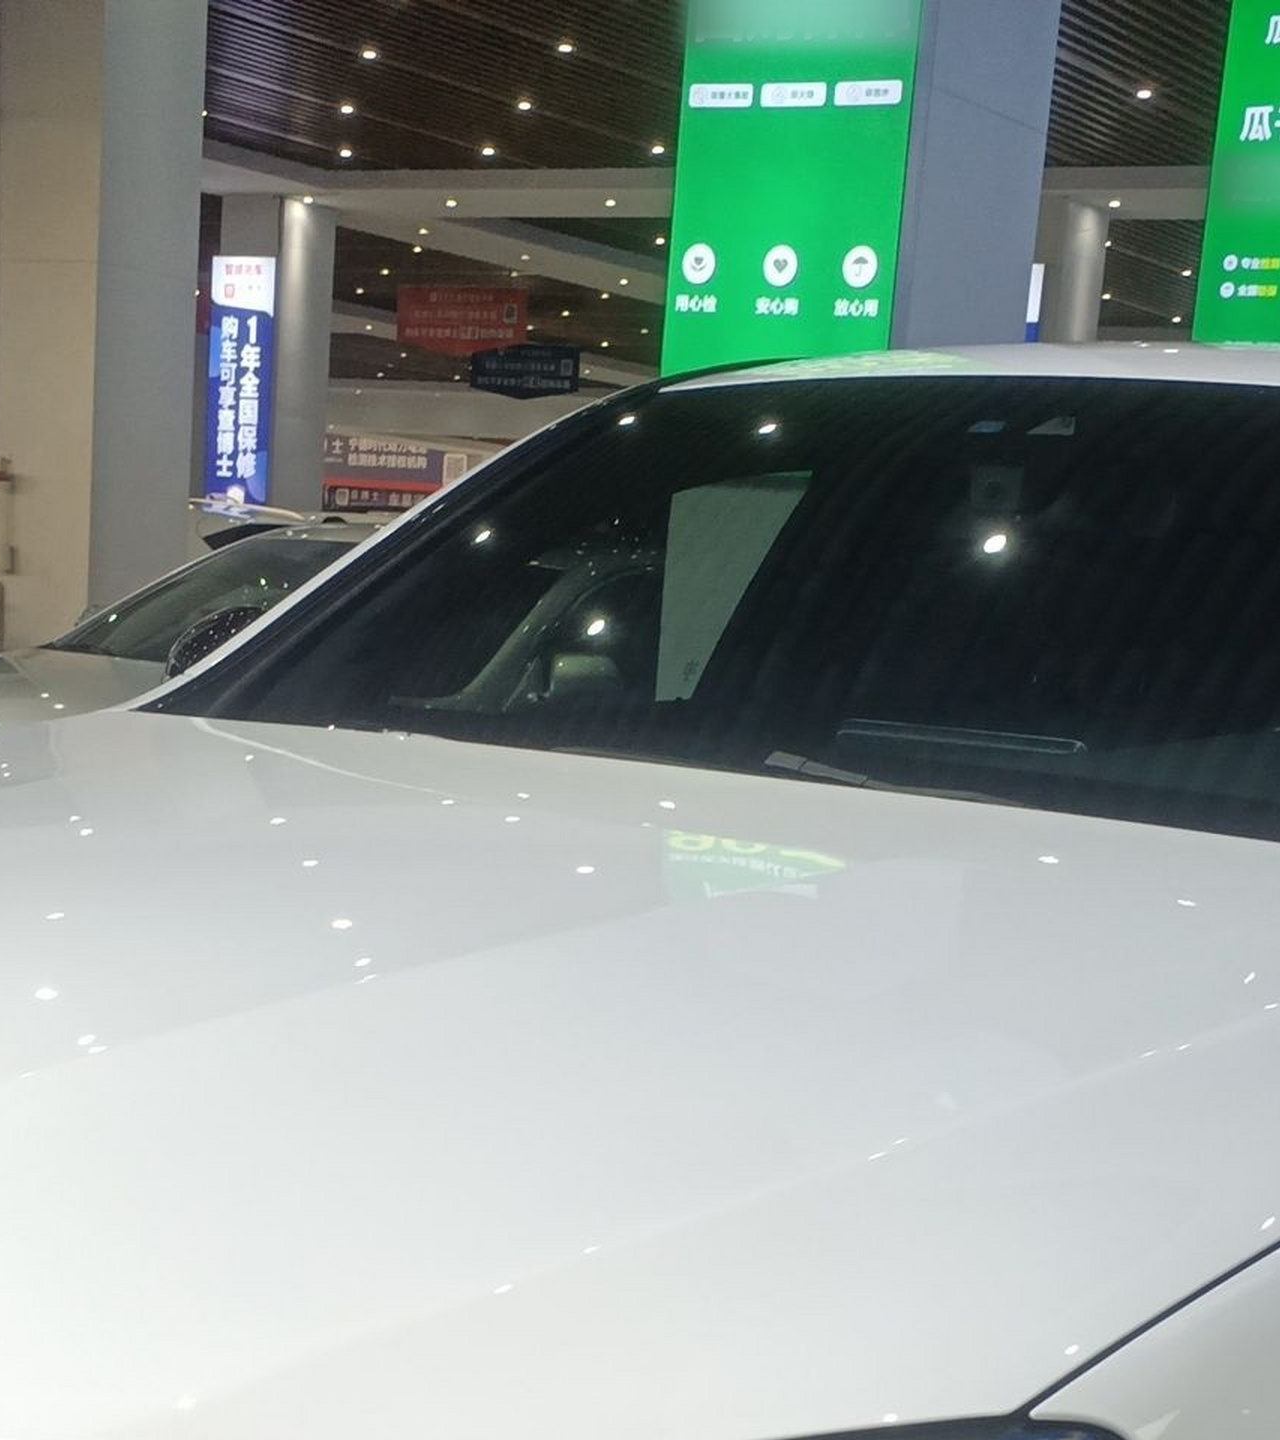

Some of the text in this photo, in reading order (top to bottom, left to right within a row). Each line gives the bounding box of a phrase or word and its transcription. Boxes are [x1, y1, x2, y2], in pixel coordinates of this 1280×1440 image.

[675, 294, 717, 313] 用心检
[755, 296, 799, 316] 安心购
[833, 297, 879, 317] 放心用
[216, 315, 239, 478] 购车可享查博士
[236, 315, 261, 479] 1年全国保修
